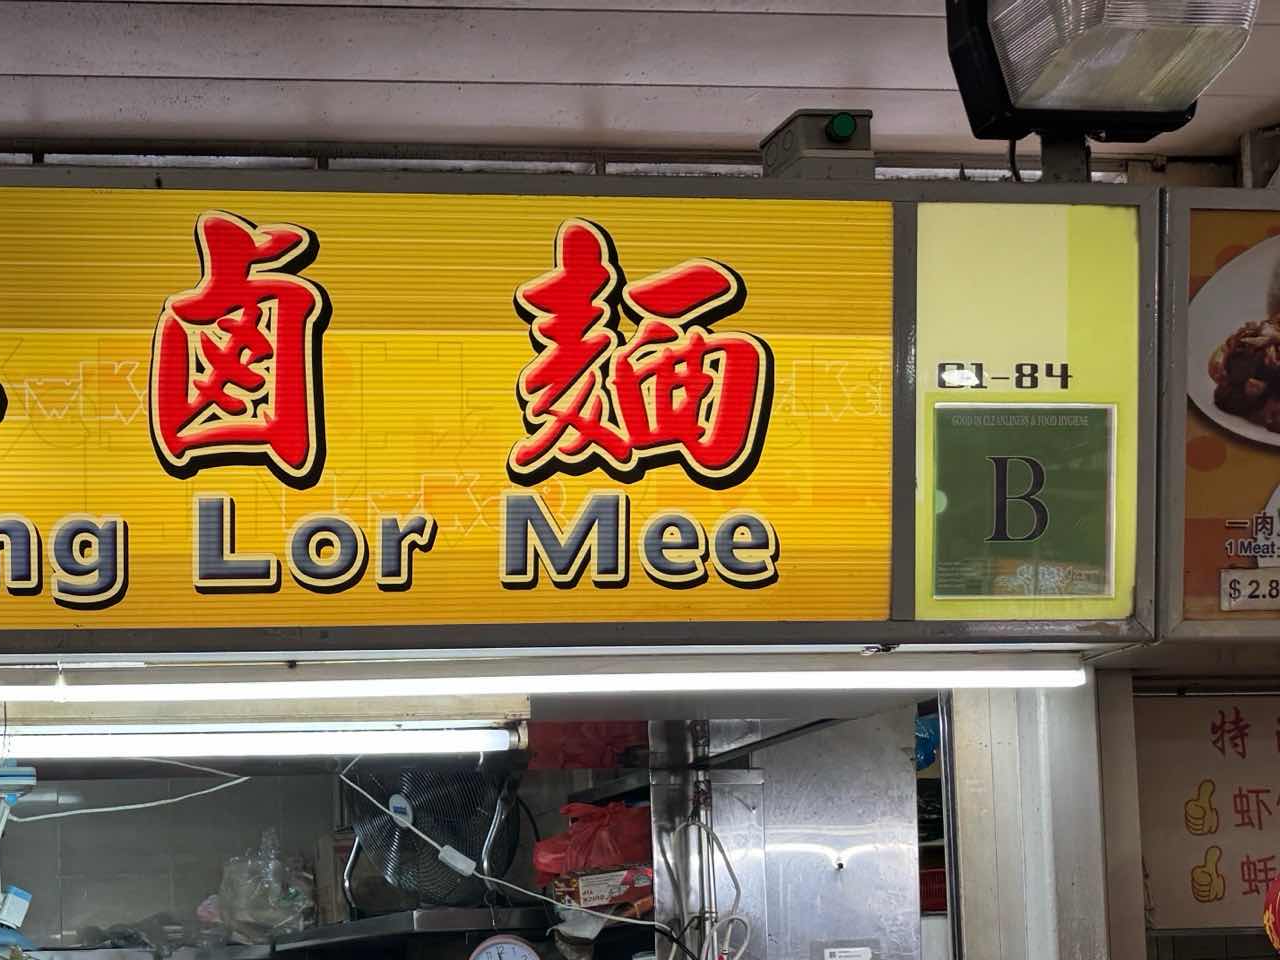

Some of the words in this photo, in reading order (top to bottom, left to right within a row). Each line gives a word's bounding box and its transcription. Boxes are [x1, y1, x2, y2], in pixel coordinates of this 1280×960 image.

[951, 415, 972, 426] GOOD
[1036, 415, 1058, 426] FOOD
[193, 490, 438, 591] Lor
[501, 490, 780, 590] Mee
[984, 456, 1050, 543] B
